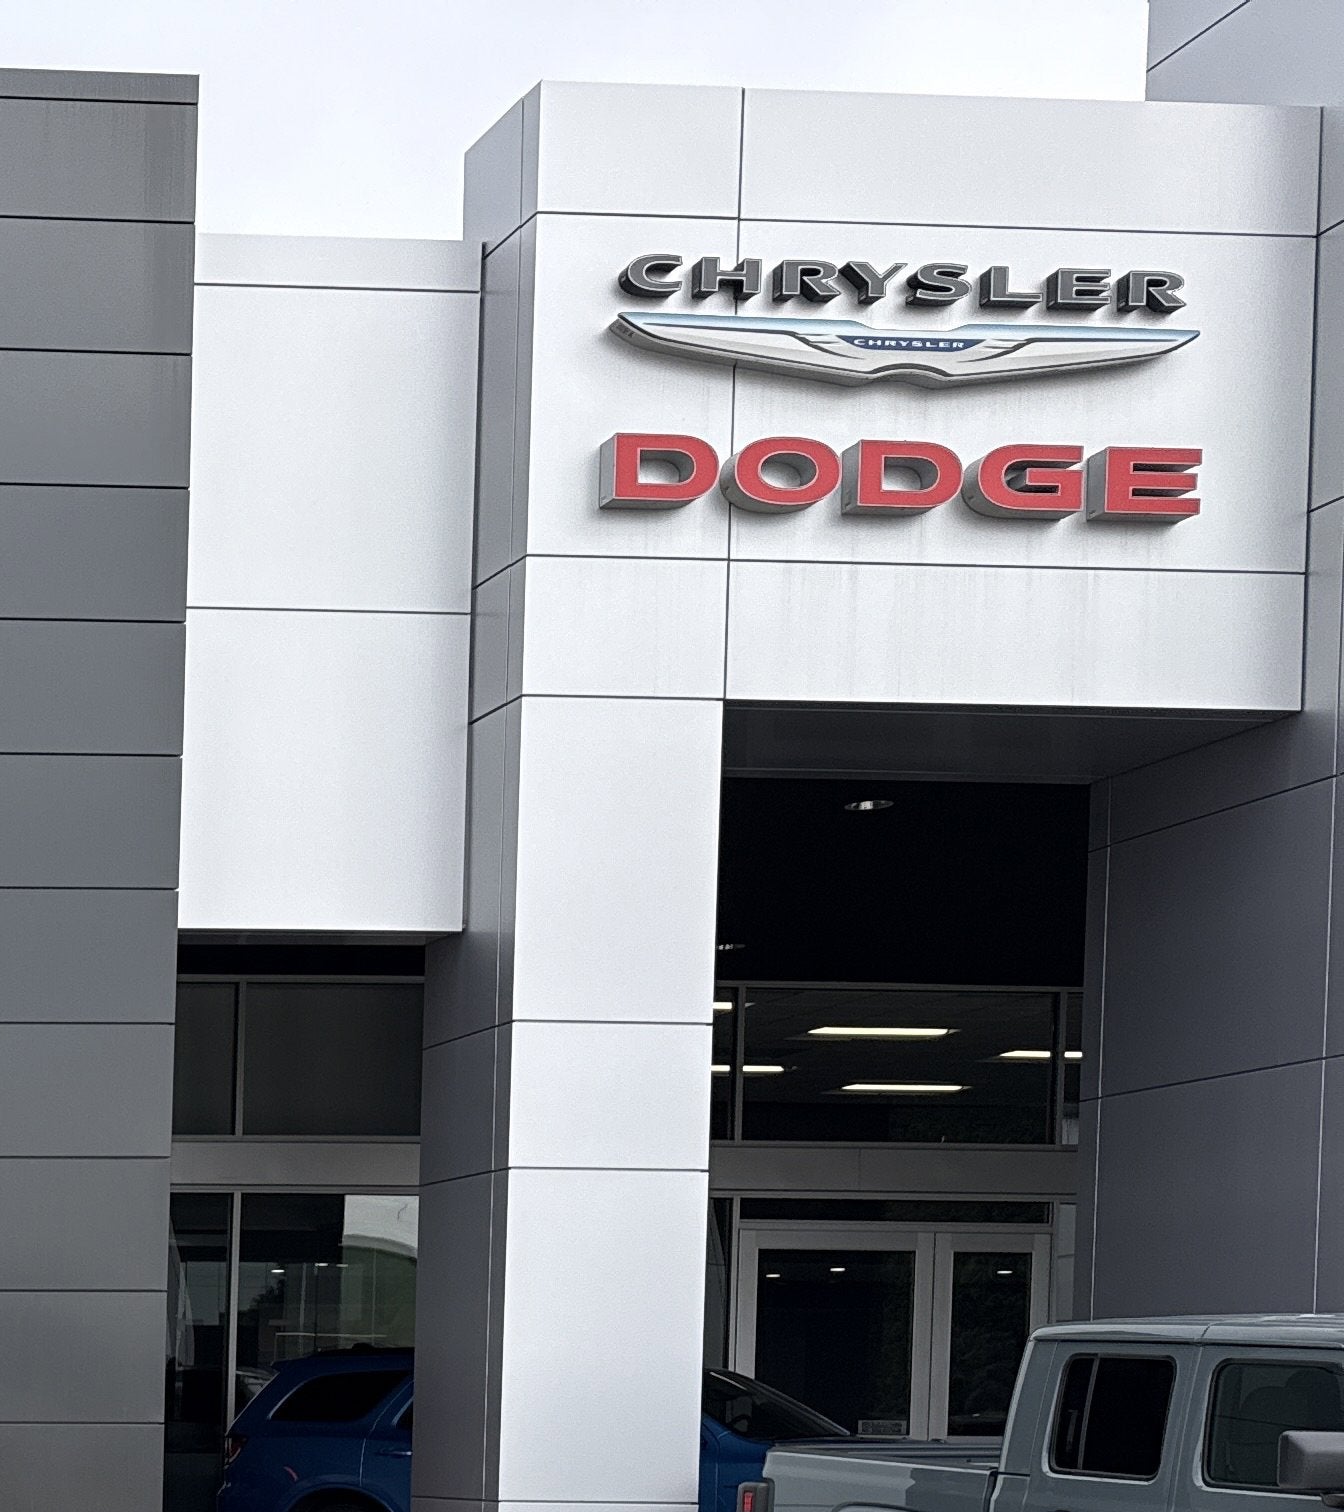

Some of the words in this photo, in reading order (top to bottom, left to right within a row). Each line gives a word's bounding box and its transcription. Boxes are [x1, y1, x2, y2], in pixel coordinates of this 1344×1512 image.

[619, 253, 1187, 312] CHRYSLER
[852, 338, 965, 349] CHRYSLER
[600, 431, 1203, 522] DODGE
